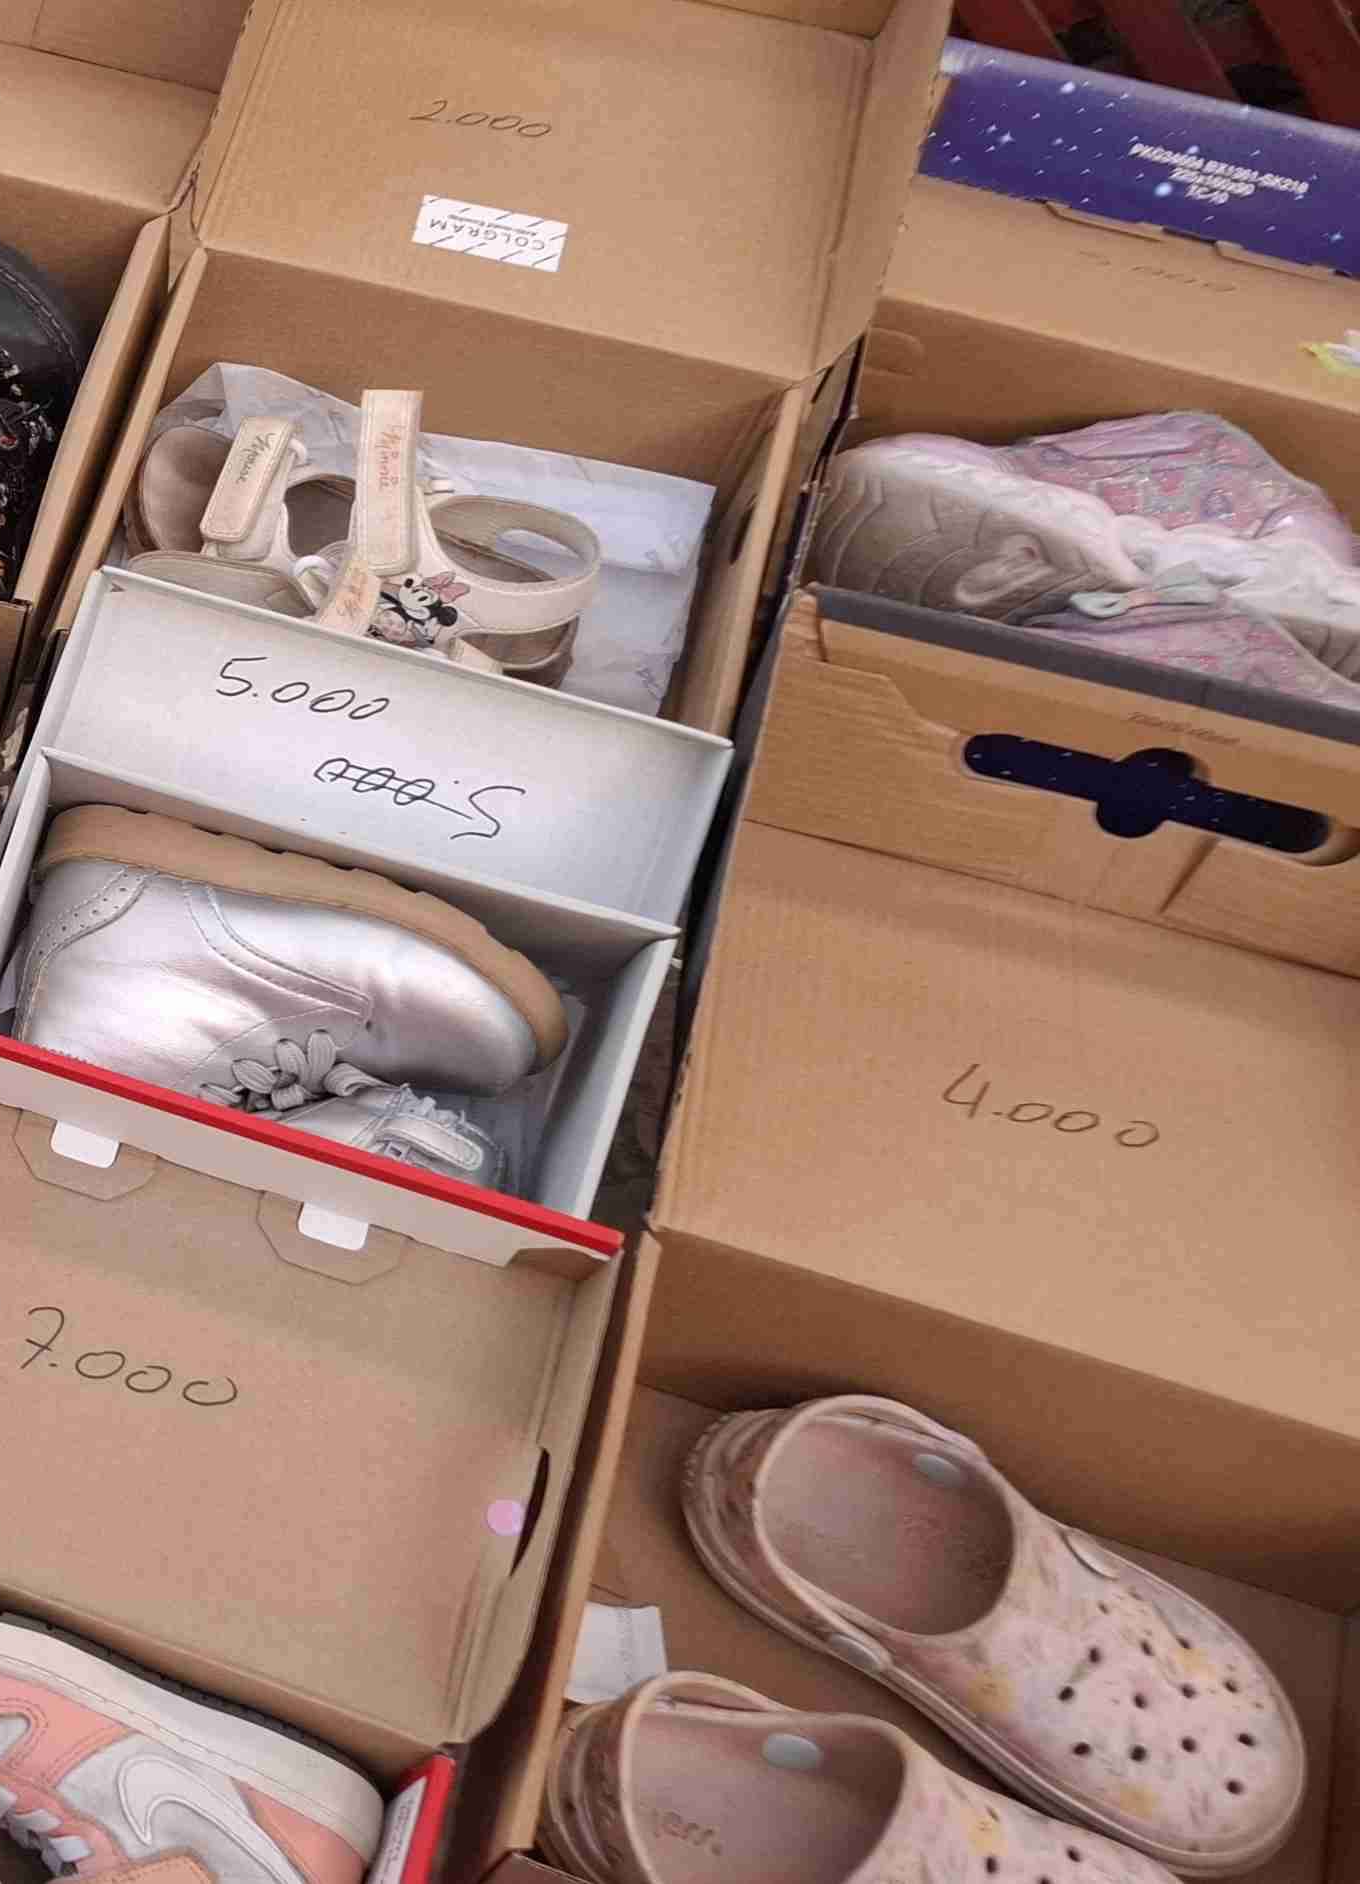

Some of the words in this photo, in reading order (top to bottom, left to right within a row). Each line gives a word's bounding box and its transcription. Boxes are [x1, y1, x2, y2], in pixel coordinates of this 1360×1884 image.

[408, 99, 552, 137] 2.000
[429, 218, 546, 251] COLGRAM
[215, 656, 390, 720] 5.000
[942, 1063, 1160, 1149] 4.000
[20, 1306, 238, 1407] 7.000
